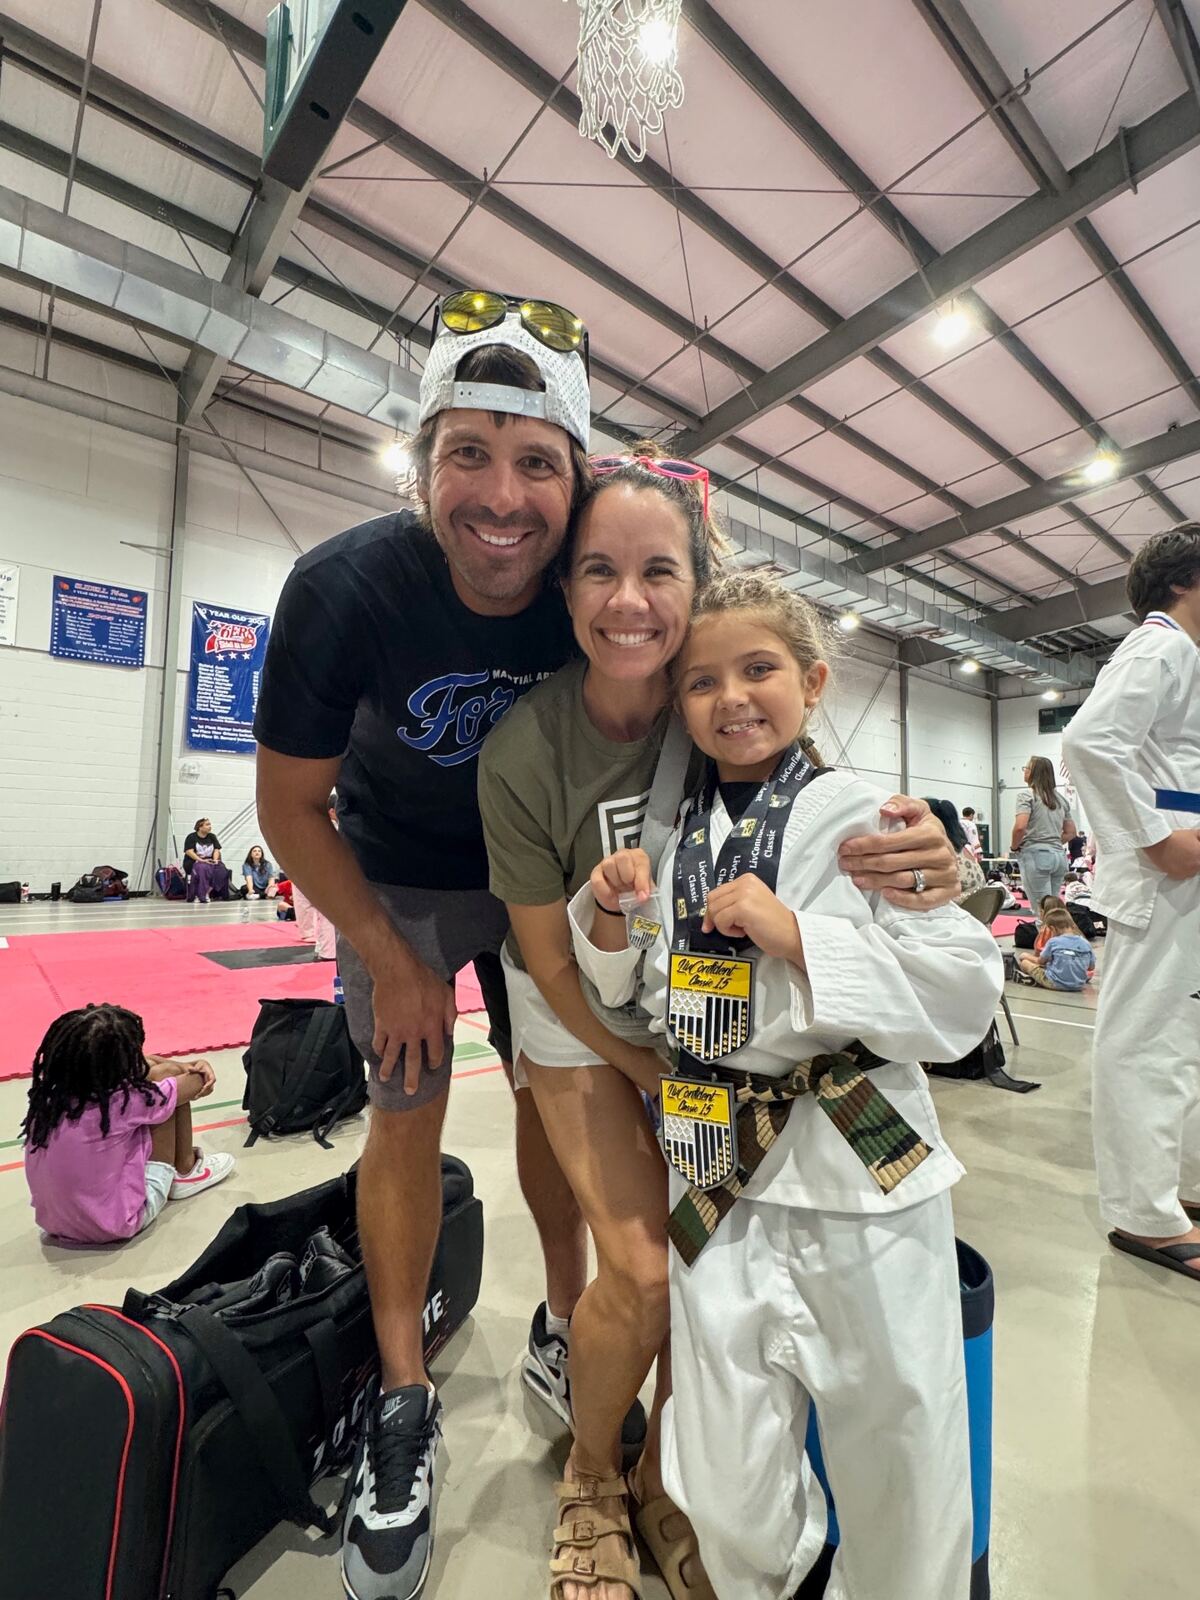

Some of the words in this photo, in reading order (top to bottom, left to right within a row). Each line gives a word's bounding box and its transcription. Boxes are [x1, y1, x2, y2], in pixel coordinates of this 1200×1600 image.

[209, 610, 230, 619] YEAR
[232, 614, 247, 622] OLD
[764, 829, 776, 858] Classic
[688, 874, 700, 903] Classic
[688, 974, 713, 988] Classic
[713, 977, 732, 990] 15
[699, 1102, 714, 1116] 15
